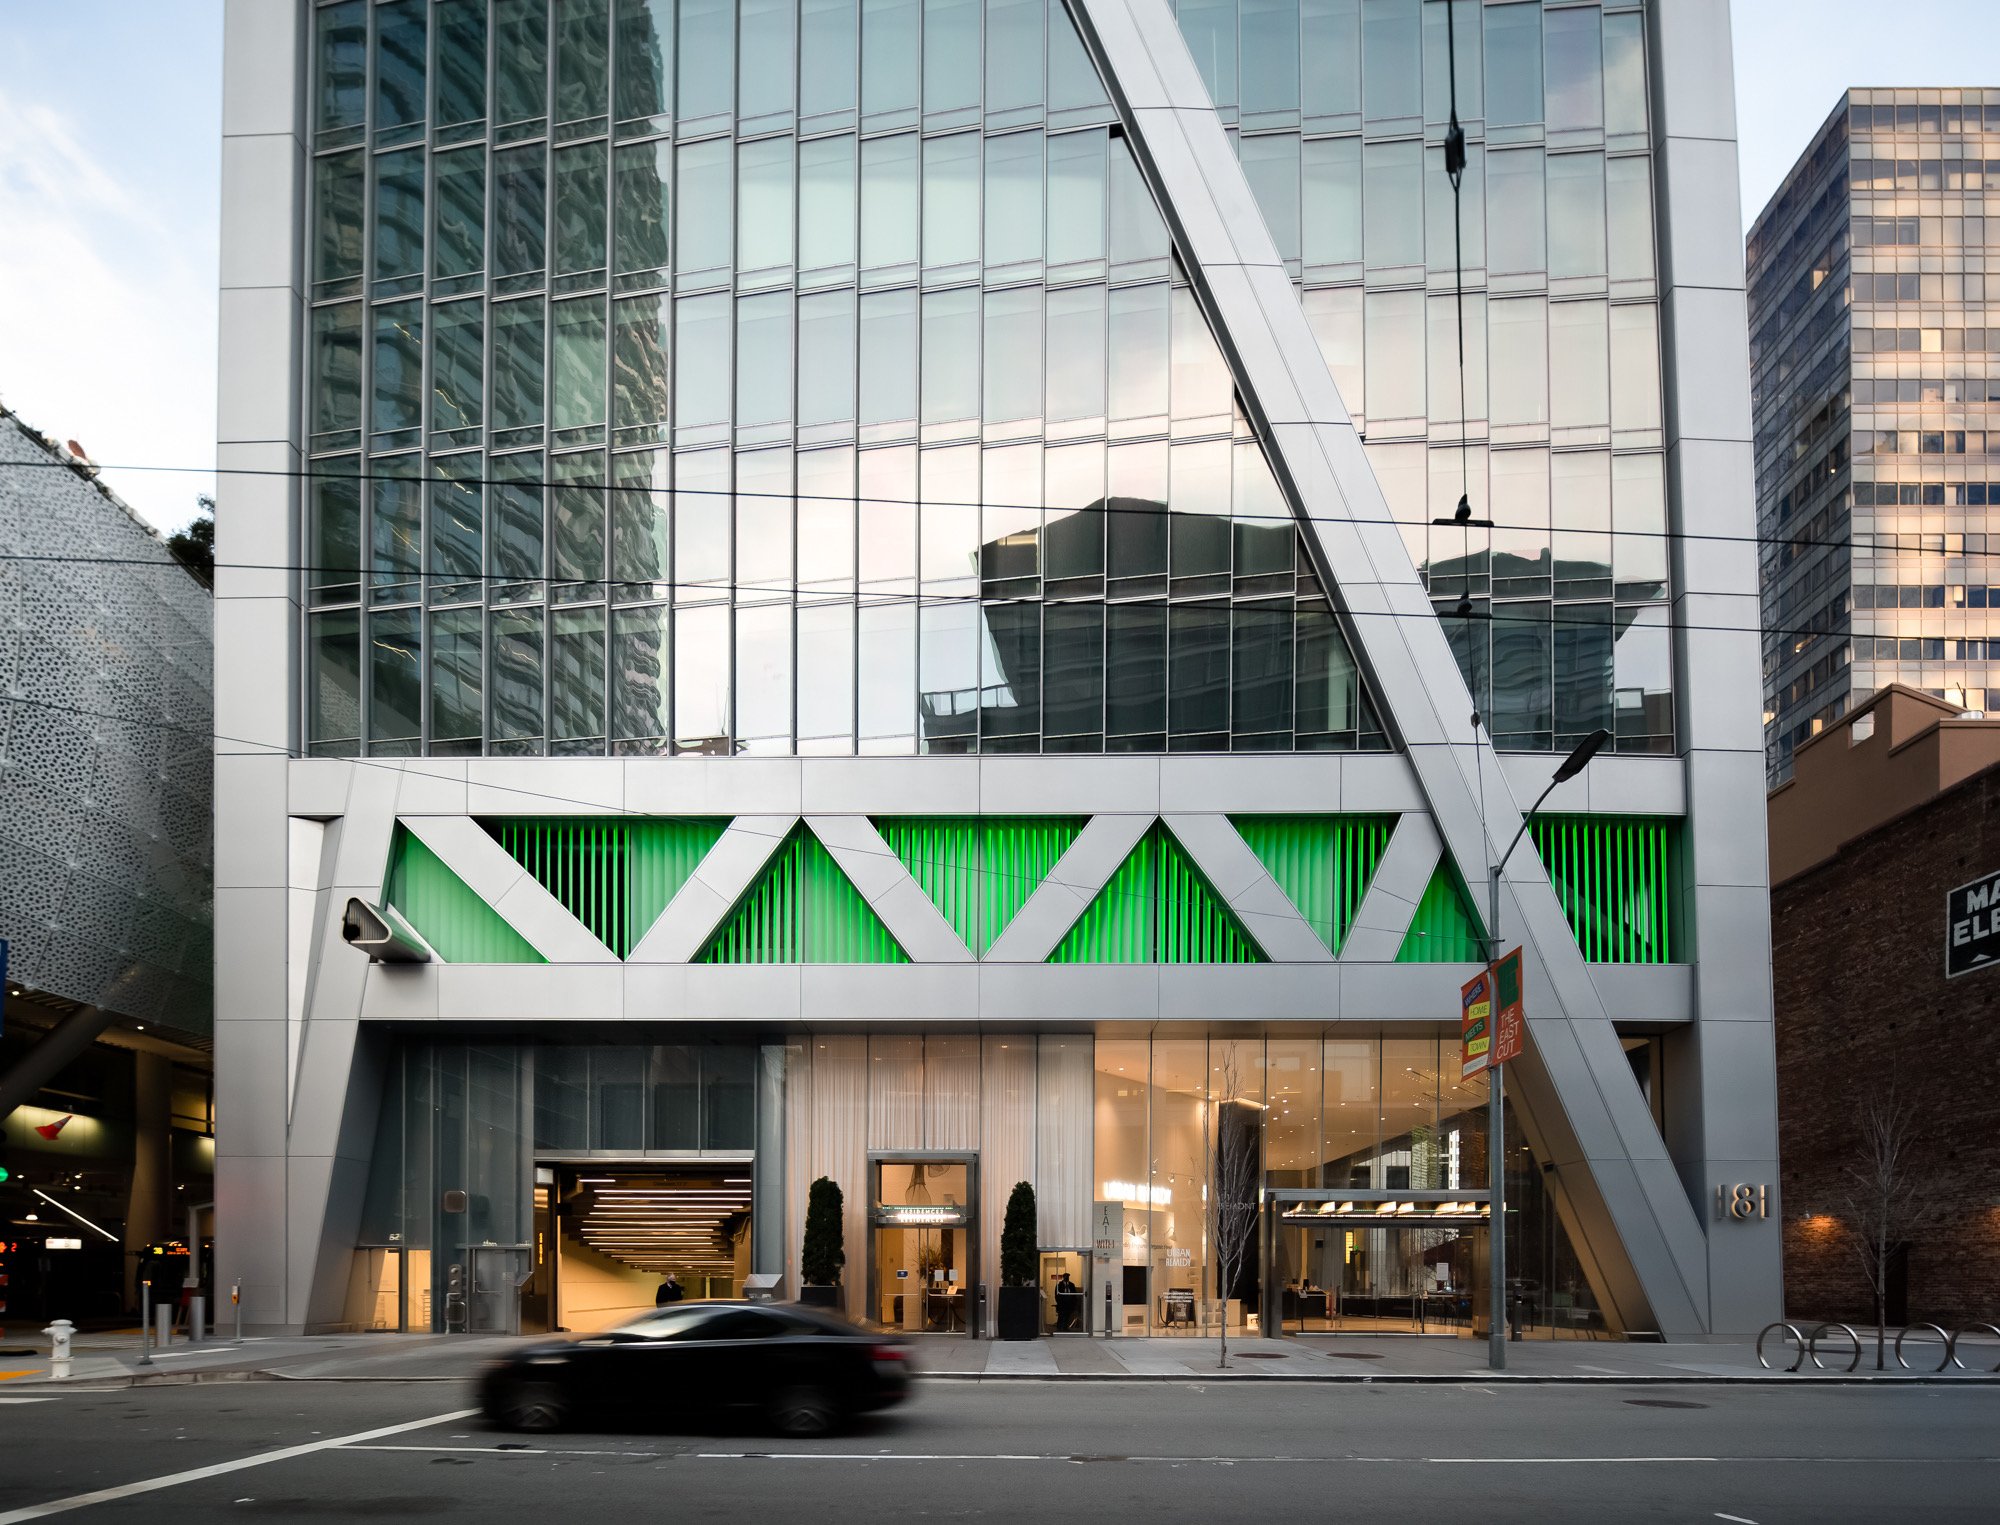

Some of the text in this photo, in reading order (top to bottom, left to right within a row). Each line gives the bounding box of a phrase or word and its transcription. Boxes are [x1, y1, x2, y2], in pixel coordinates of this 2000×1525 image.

[1464, 982, 1483, 1006] WHERE
[1470, 1004, 1488, 1017] HOME
[1501, 1008, 1515, 1028] THE
[1465, 1022, 1484, 1042] MEETS
[1499, 1021, 1520, 1045] EAST
[1470, 1040, 1488, 1053] TOWN
[1497, 1039, 1514, 1060] CUT
[1714, 1182, 1773, 1220] 181
[1165, 1257, 1192, 1267] REMEDY
